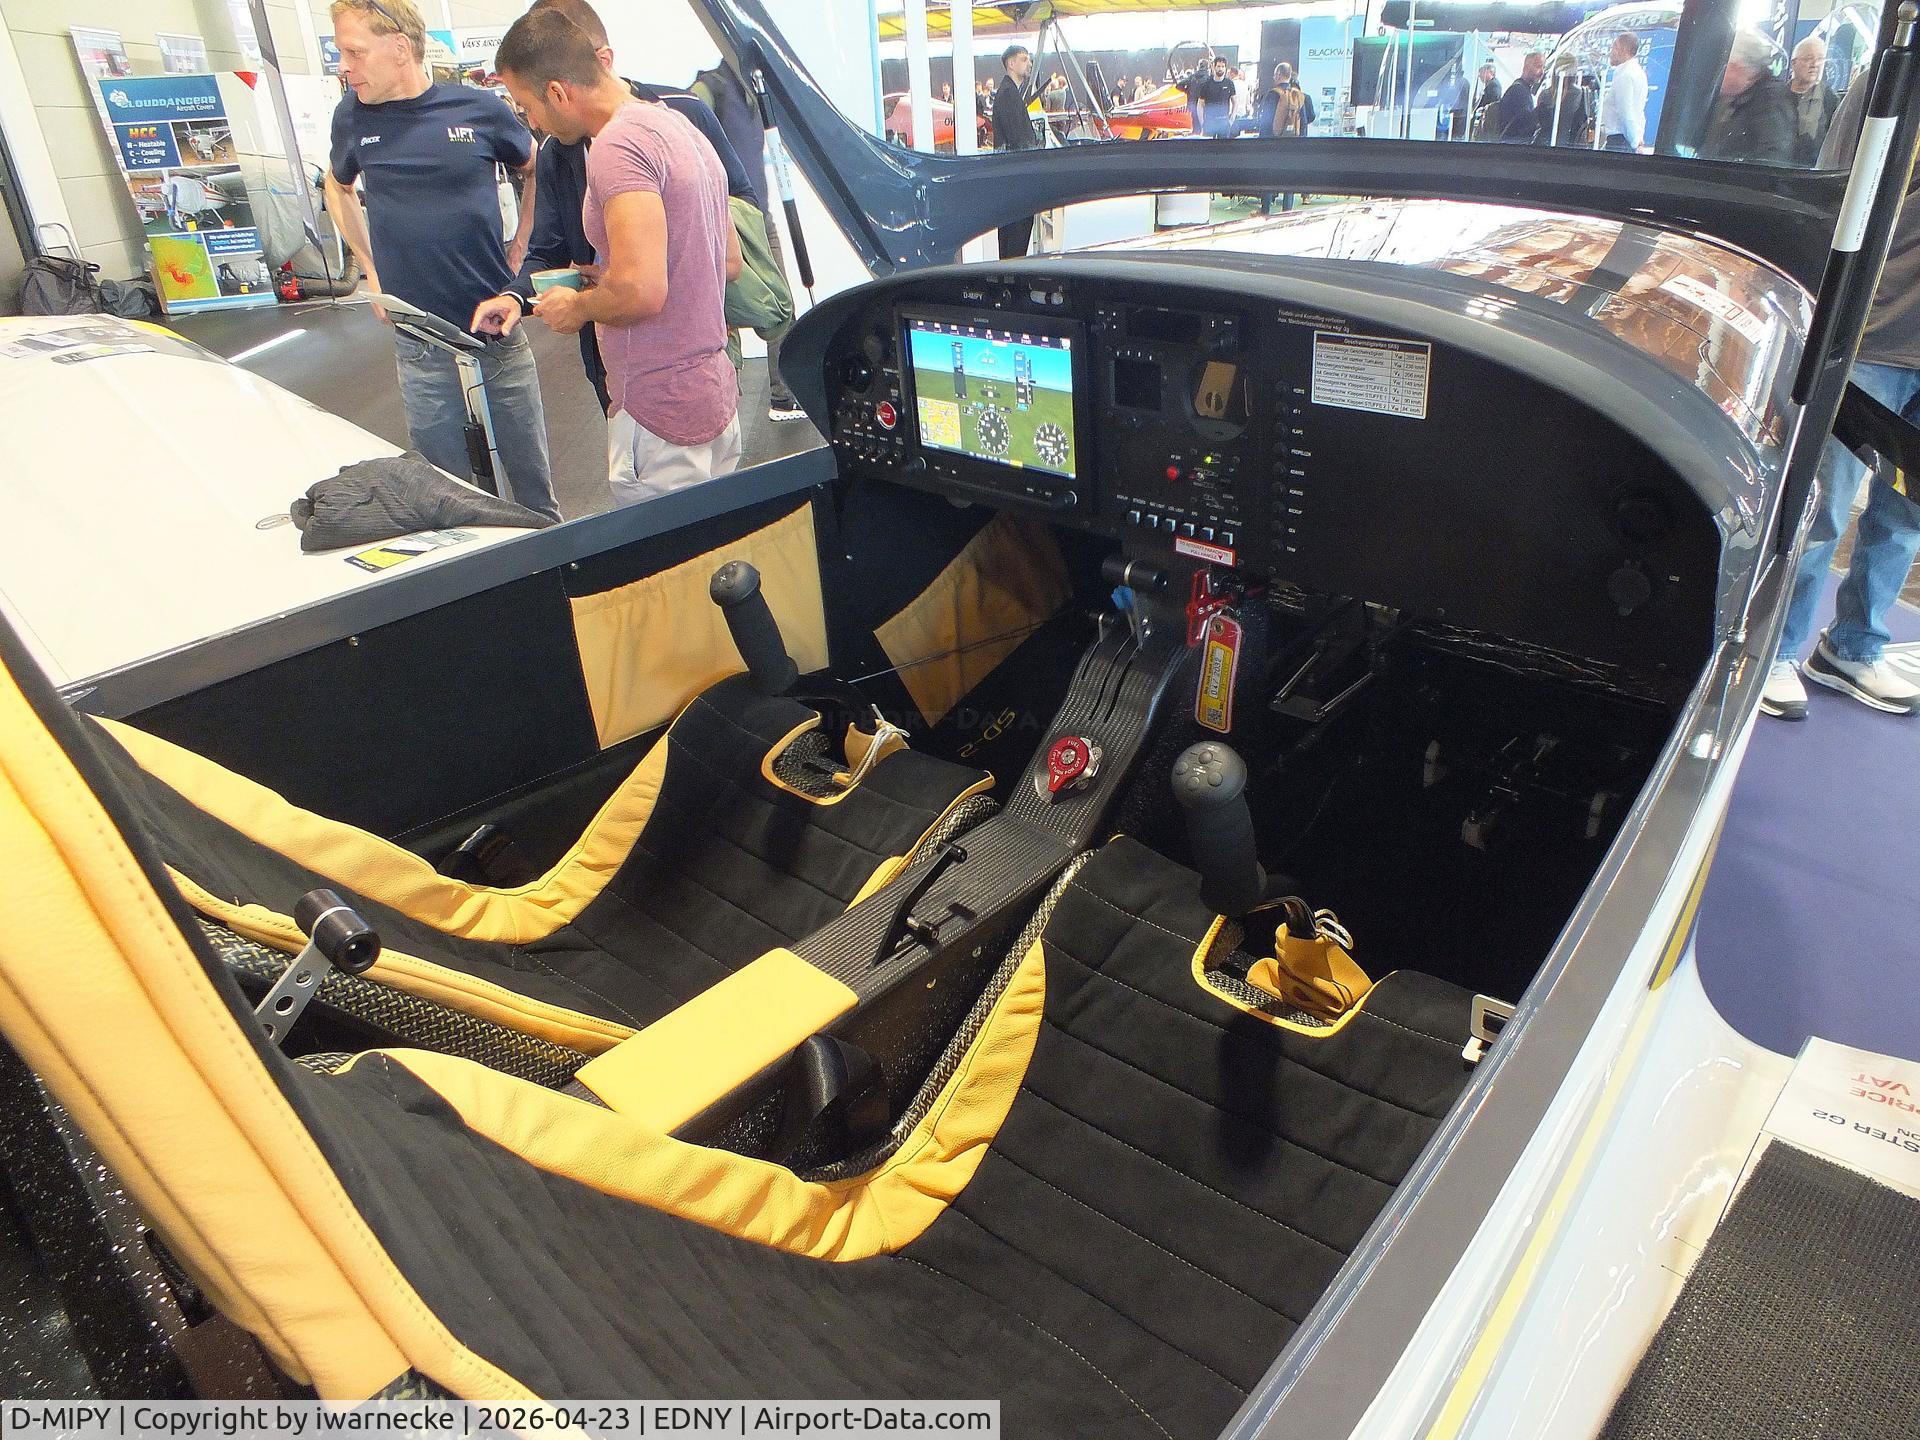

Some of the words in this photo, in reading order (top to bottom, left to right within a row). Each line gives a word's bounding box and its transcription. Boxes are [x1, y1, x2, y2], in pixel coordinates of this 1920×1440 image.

[1308, 48, 1354, 57] BLACKWN
[128, 126, 158, 139] HCC
[447, 127, 475, 139] LIFT
[141, 149, 166, 157] Cowling
[143, 157, 161, 165] Cover
[1067, 740, 1080, 748] FUEL
[1851, 1073, 1911, 1097] VAT
[1812, 1109, 1846, 1125] G2
